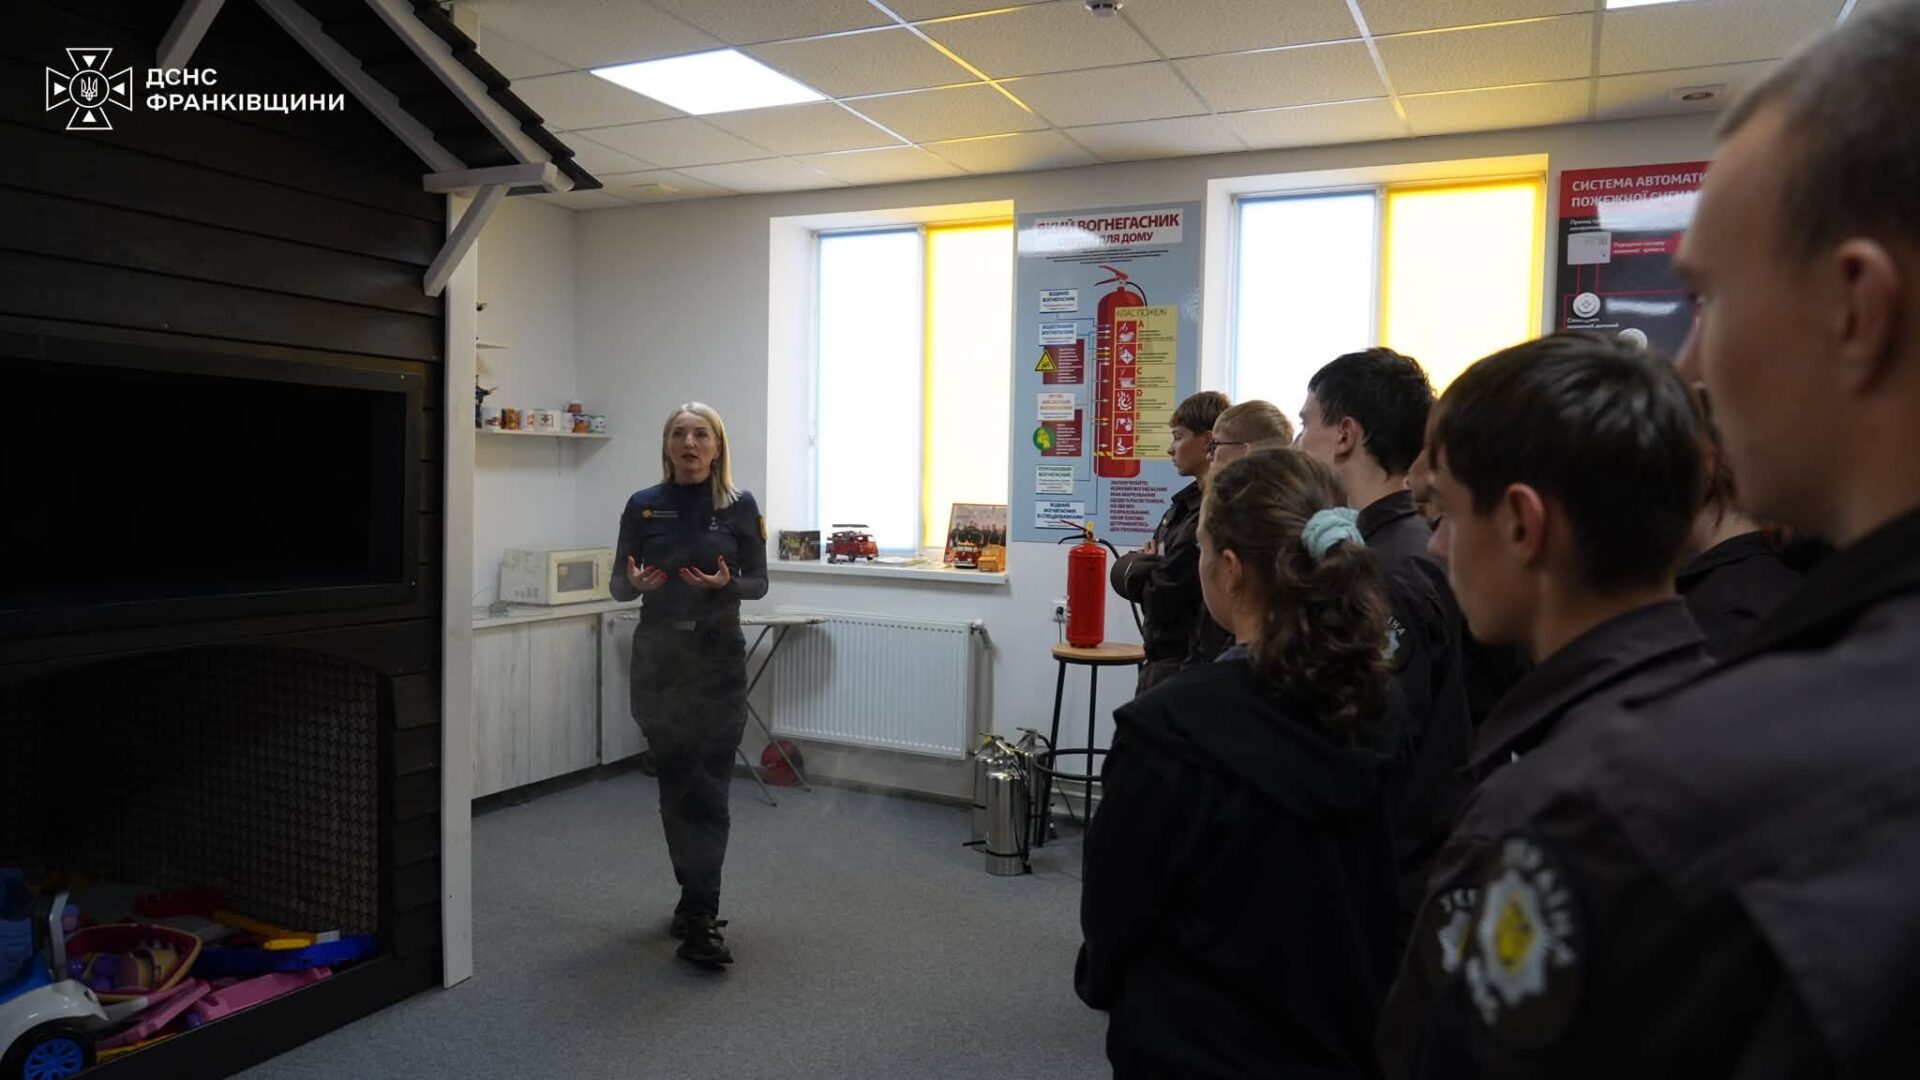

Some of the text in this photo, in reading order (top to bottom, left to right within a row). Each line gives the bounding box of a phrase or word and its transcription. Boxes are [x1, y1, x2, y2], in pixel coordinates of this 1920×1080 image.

[1572, 172, 1709, 192] СИСТЕМА АВТОМАТИ
[1077, 213, 1180, 232] ВОГНЕГАСНИК
[1121, 231, 1153, 245] ДОМУ
